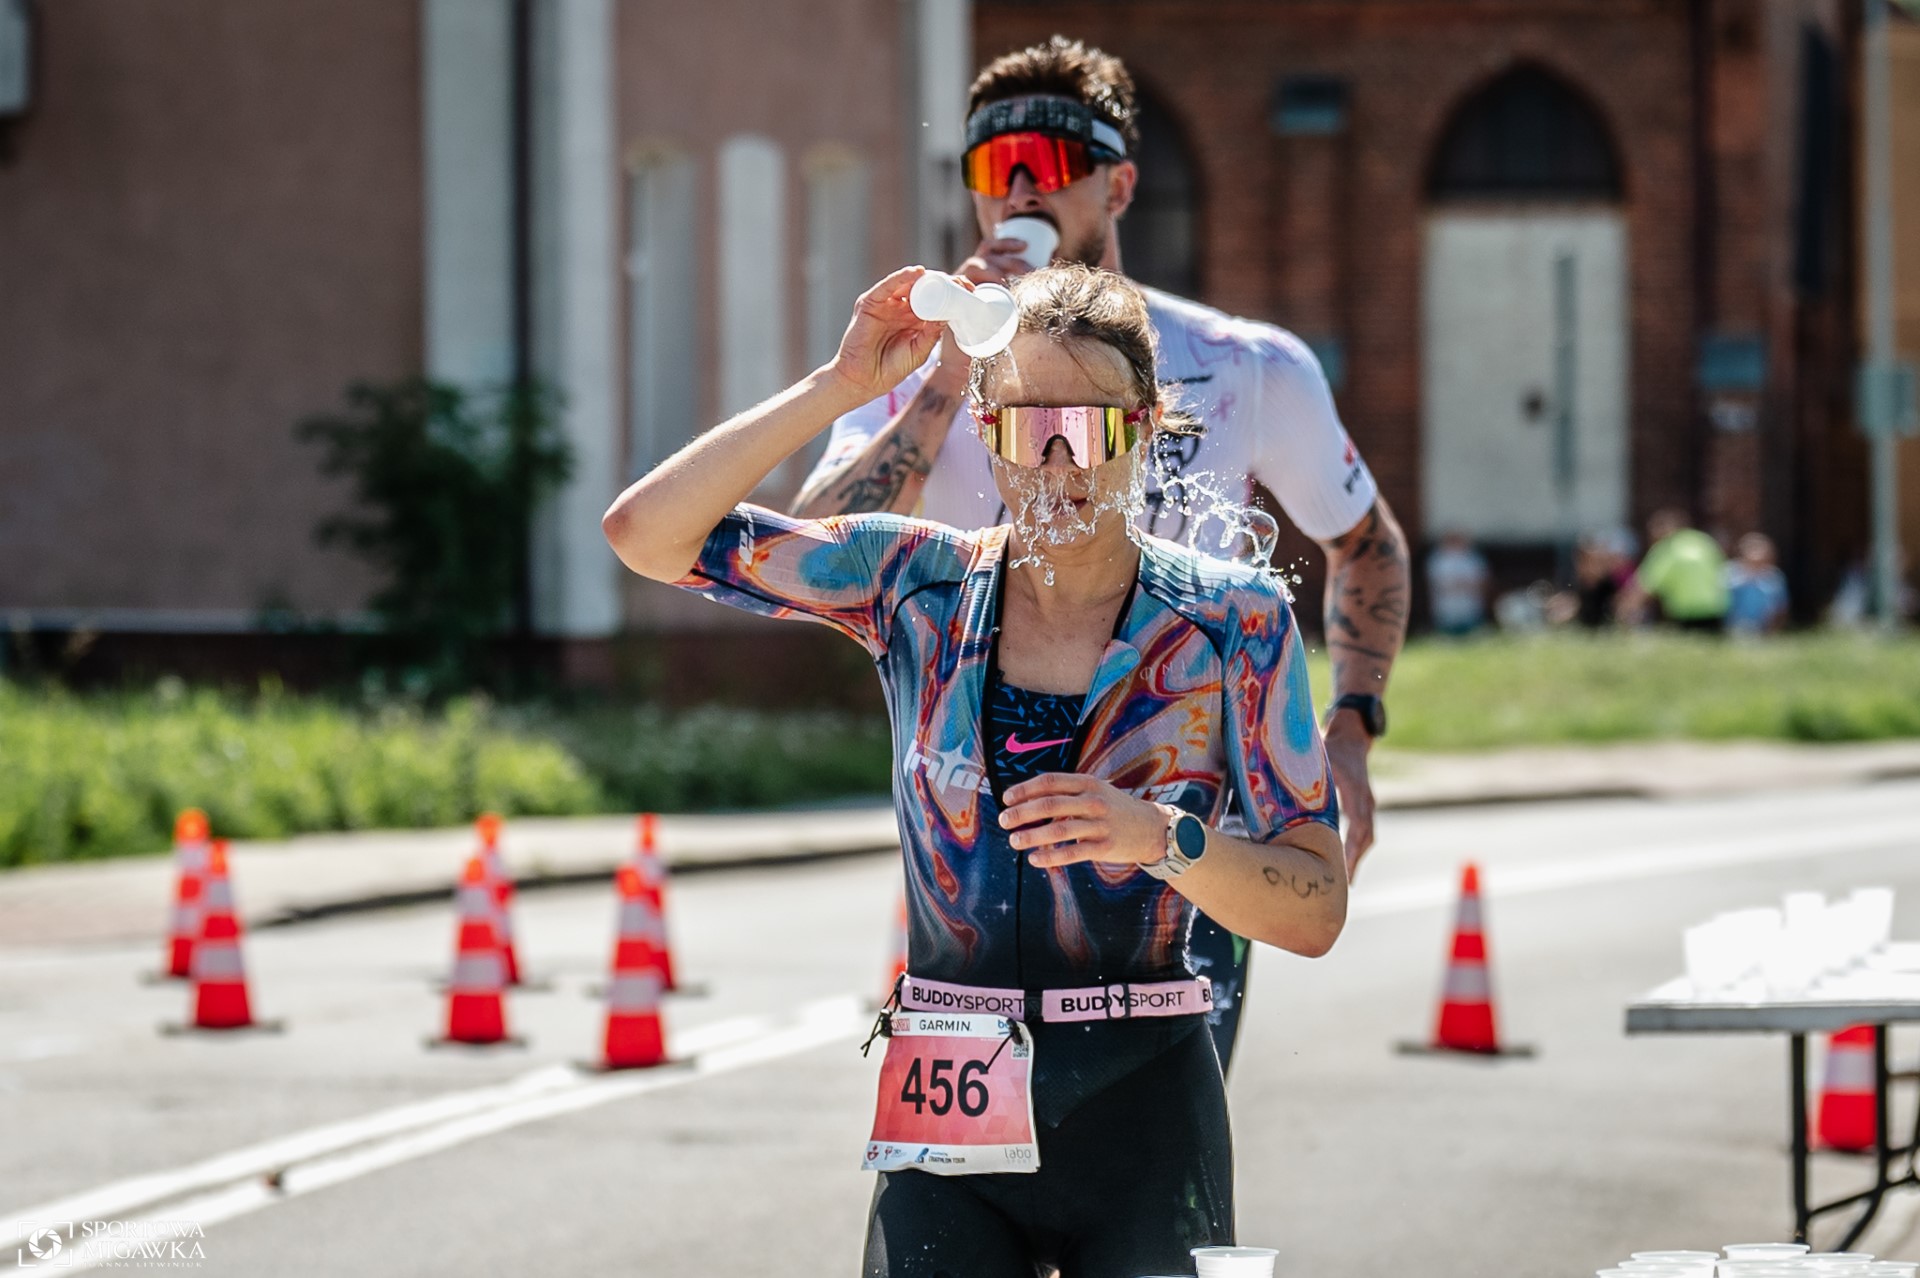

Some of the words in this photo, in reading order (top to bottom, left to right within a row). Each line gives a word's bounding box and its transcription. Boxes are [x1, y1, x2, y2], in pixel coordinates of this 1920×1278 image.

[912, 986, 1024, 1012] BUDDYSPORT
[919, 1019, 971, 1032] GARMIN
[901, 1057, 989, 1117] 456
[1004, 1147, 1032, 1159] labo
